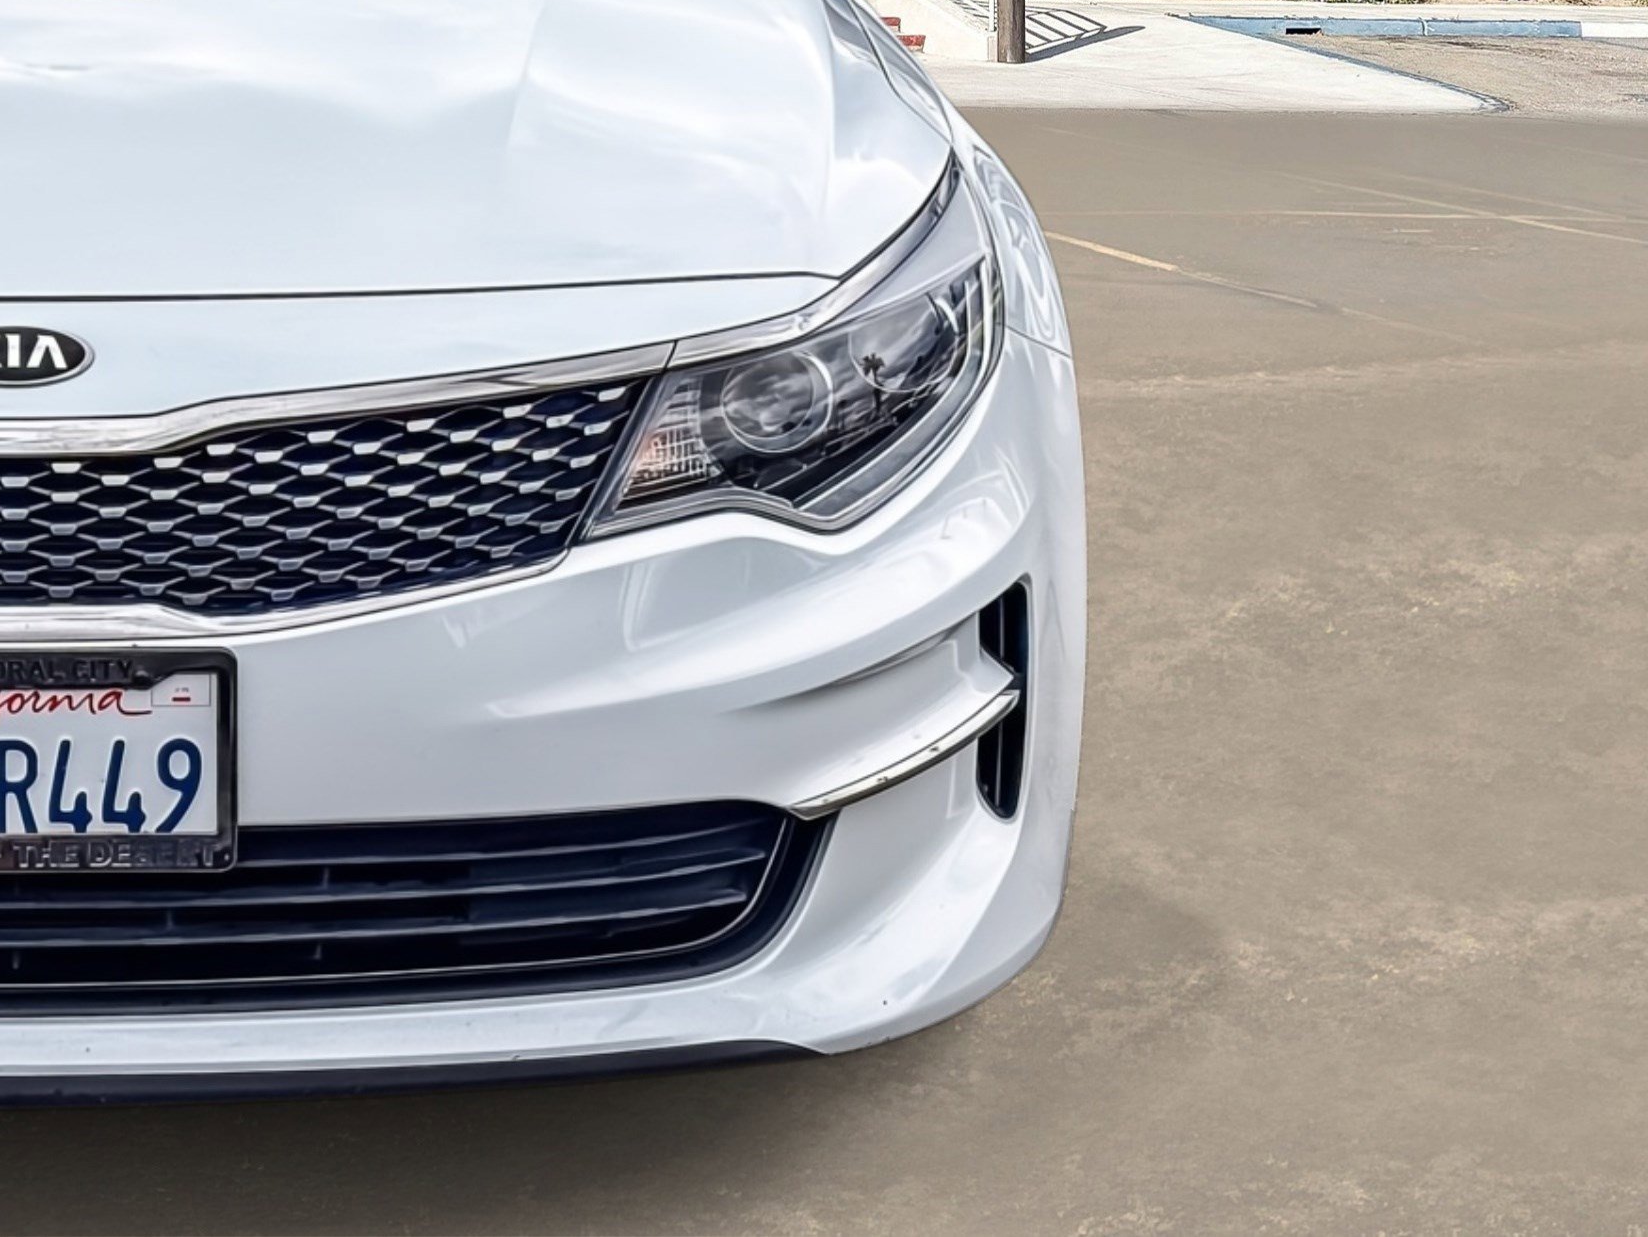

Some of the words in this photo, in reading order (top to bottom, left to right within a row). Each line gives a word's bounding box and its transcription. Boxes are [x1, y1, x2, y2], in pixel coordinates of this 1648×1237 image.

[70, 658, 135, 684] CITY
[12, 840, 81, 870] THE
[87, 840, 219, 870] DESERT
